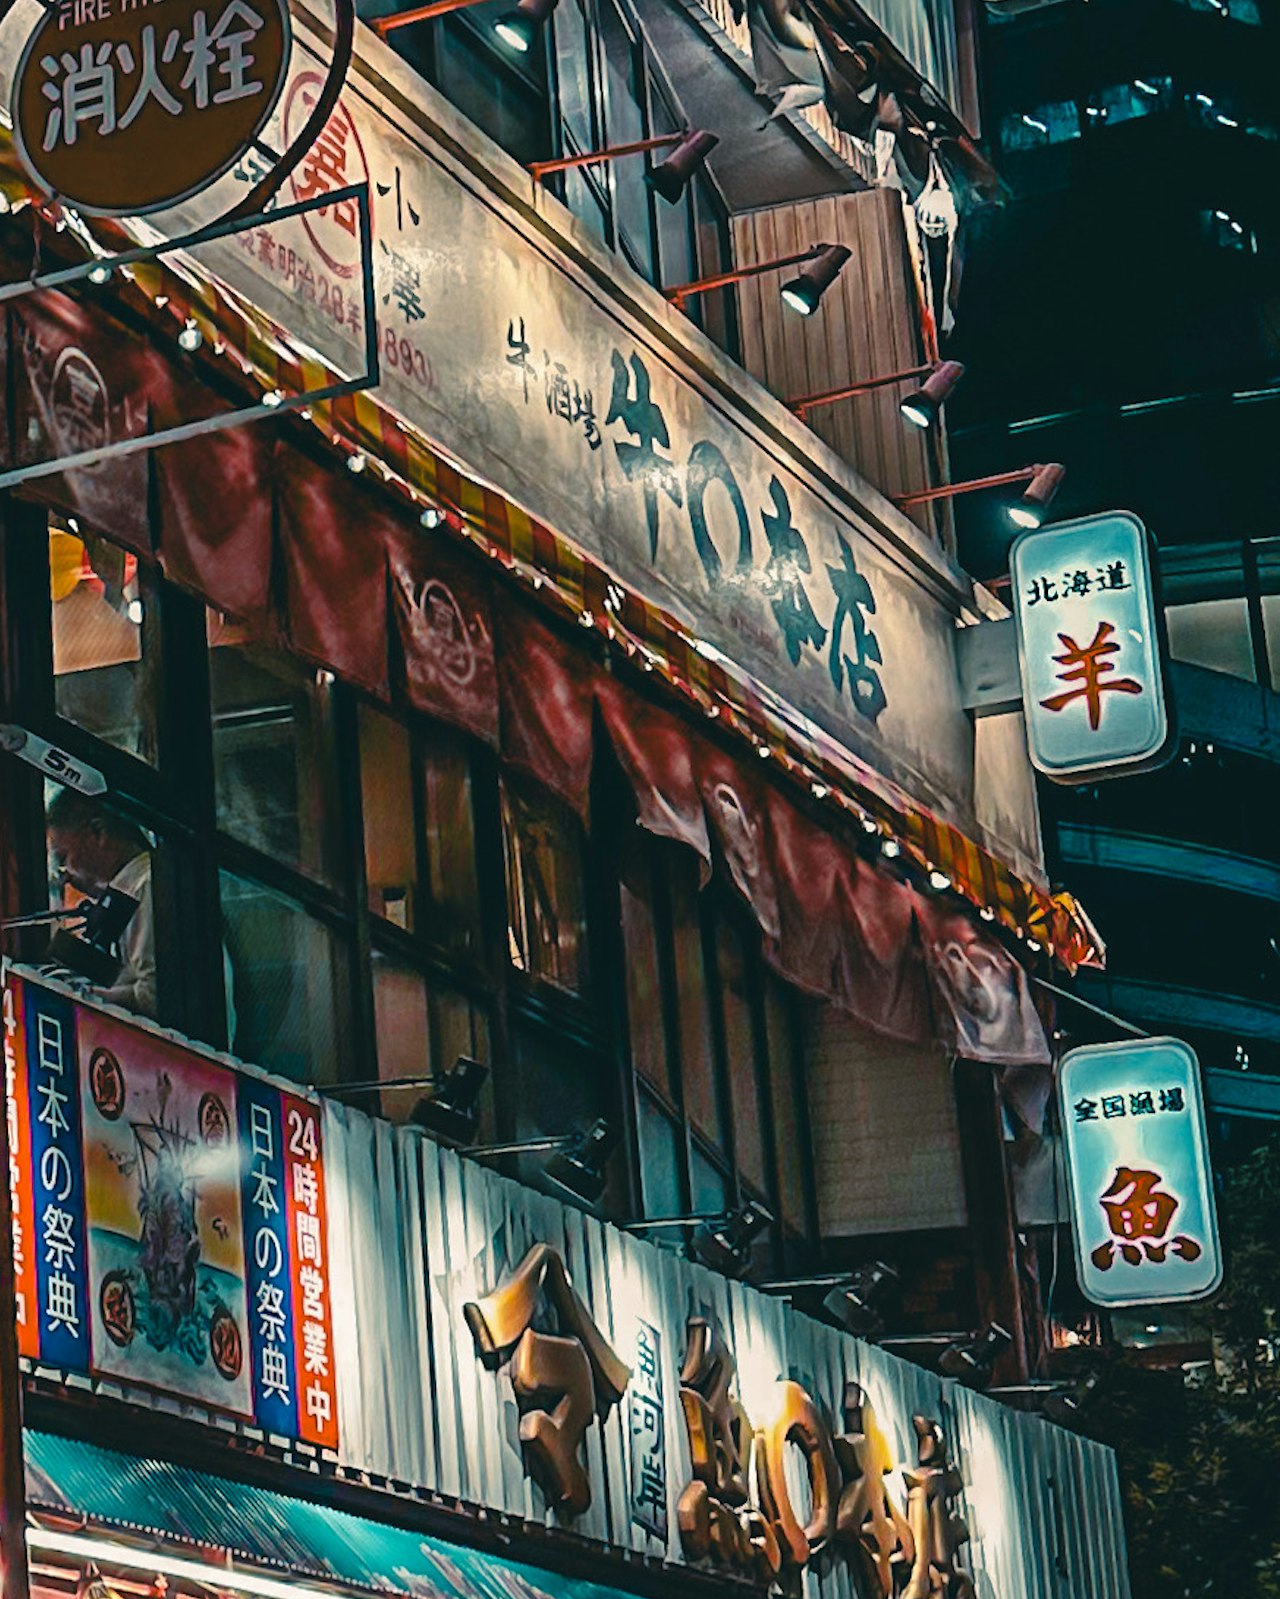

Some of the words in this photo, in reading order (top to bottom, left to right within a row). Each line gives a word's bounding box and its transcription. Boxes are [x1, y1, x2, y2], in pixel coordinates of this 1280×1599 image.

[1025, 561, 1132, 606] 北海道
[1039, 620, 1143, 732] 羊
[1073, 1086, 1185, 1122] 全国漁場
[36, 1011, 80, 1341] 日本の祭典
[1090, 1166, 1202, 1273] 魚
[250, 1101, 291, 1408] 日本の祭典
[287, 1107, 331, 1434] 24時間営業中
